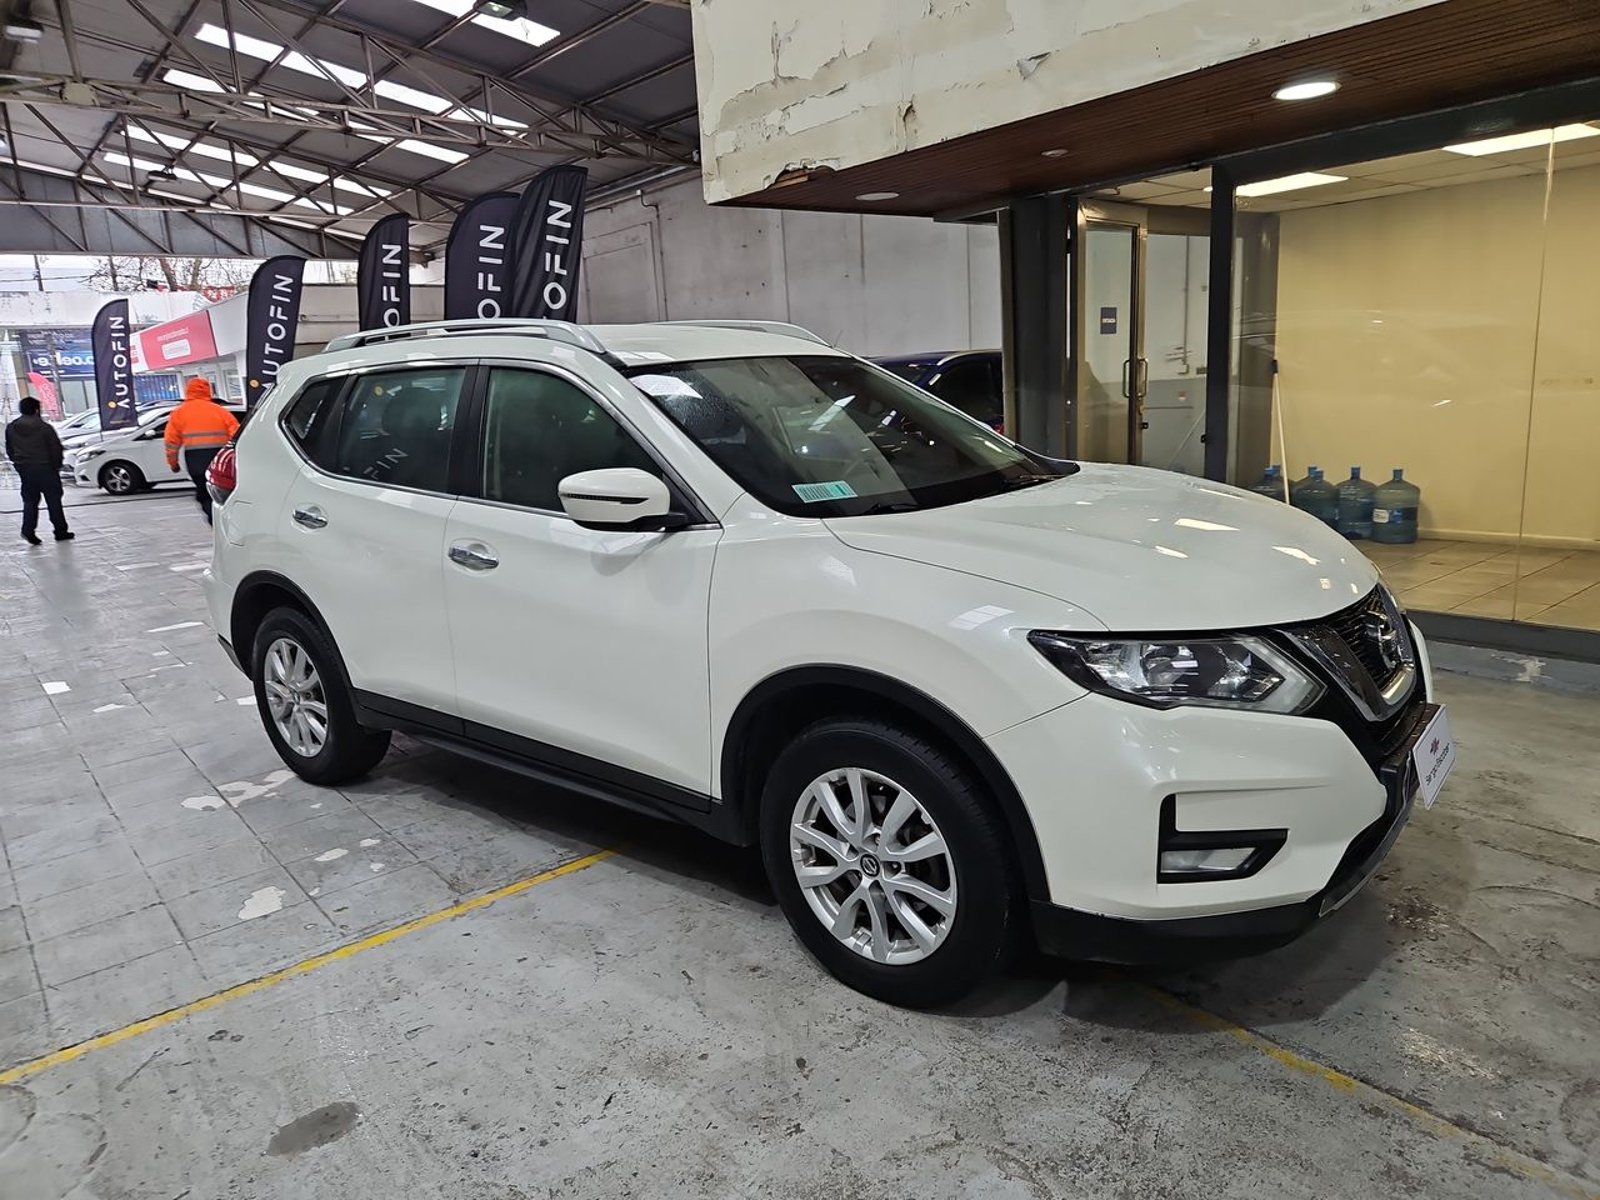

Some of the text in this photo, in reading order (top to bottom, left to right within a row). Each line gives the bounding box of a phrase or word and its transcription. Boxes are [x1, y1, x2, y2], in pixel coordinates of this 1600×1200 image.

[382, 243, 401, 327] OFIN
[477, 224, 505, 319] OFIN
[542, 199, 572, 310] OFIN
[109, 316, 131, 409] AUTOFIN
